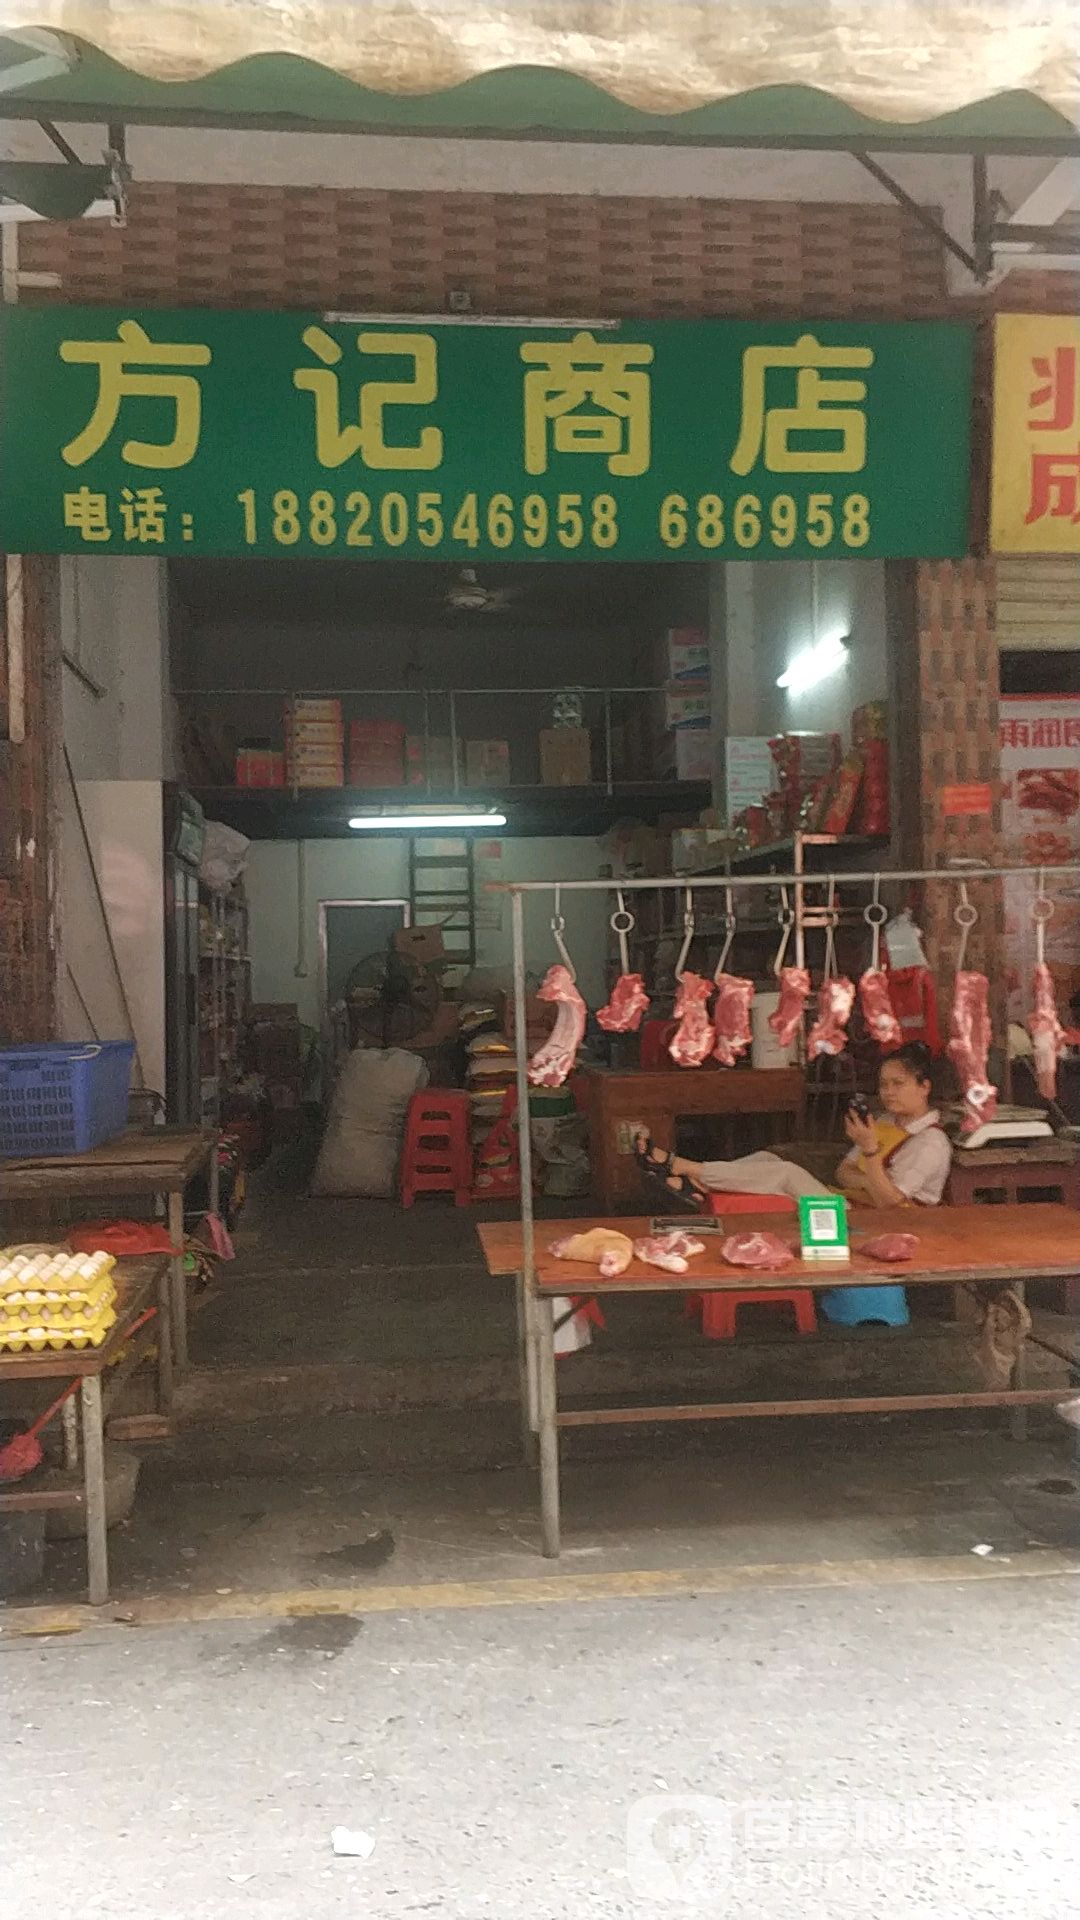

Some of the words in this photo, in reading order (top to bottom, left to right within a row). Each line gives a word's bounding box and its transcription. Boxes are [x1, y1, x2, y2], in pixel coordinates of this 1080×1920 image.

[59, 319, 875, 477] 方记商店
[237, 488, 619, 549] 18820546958
[660, 494, 871, 549] 686958
